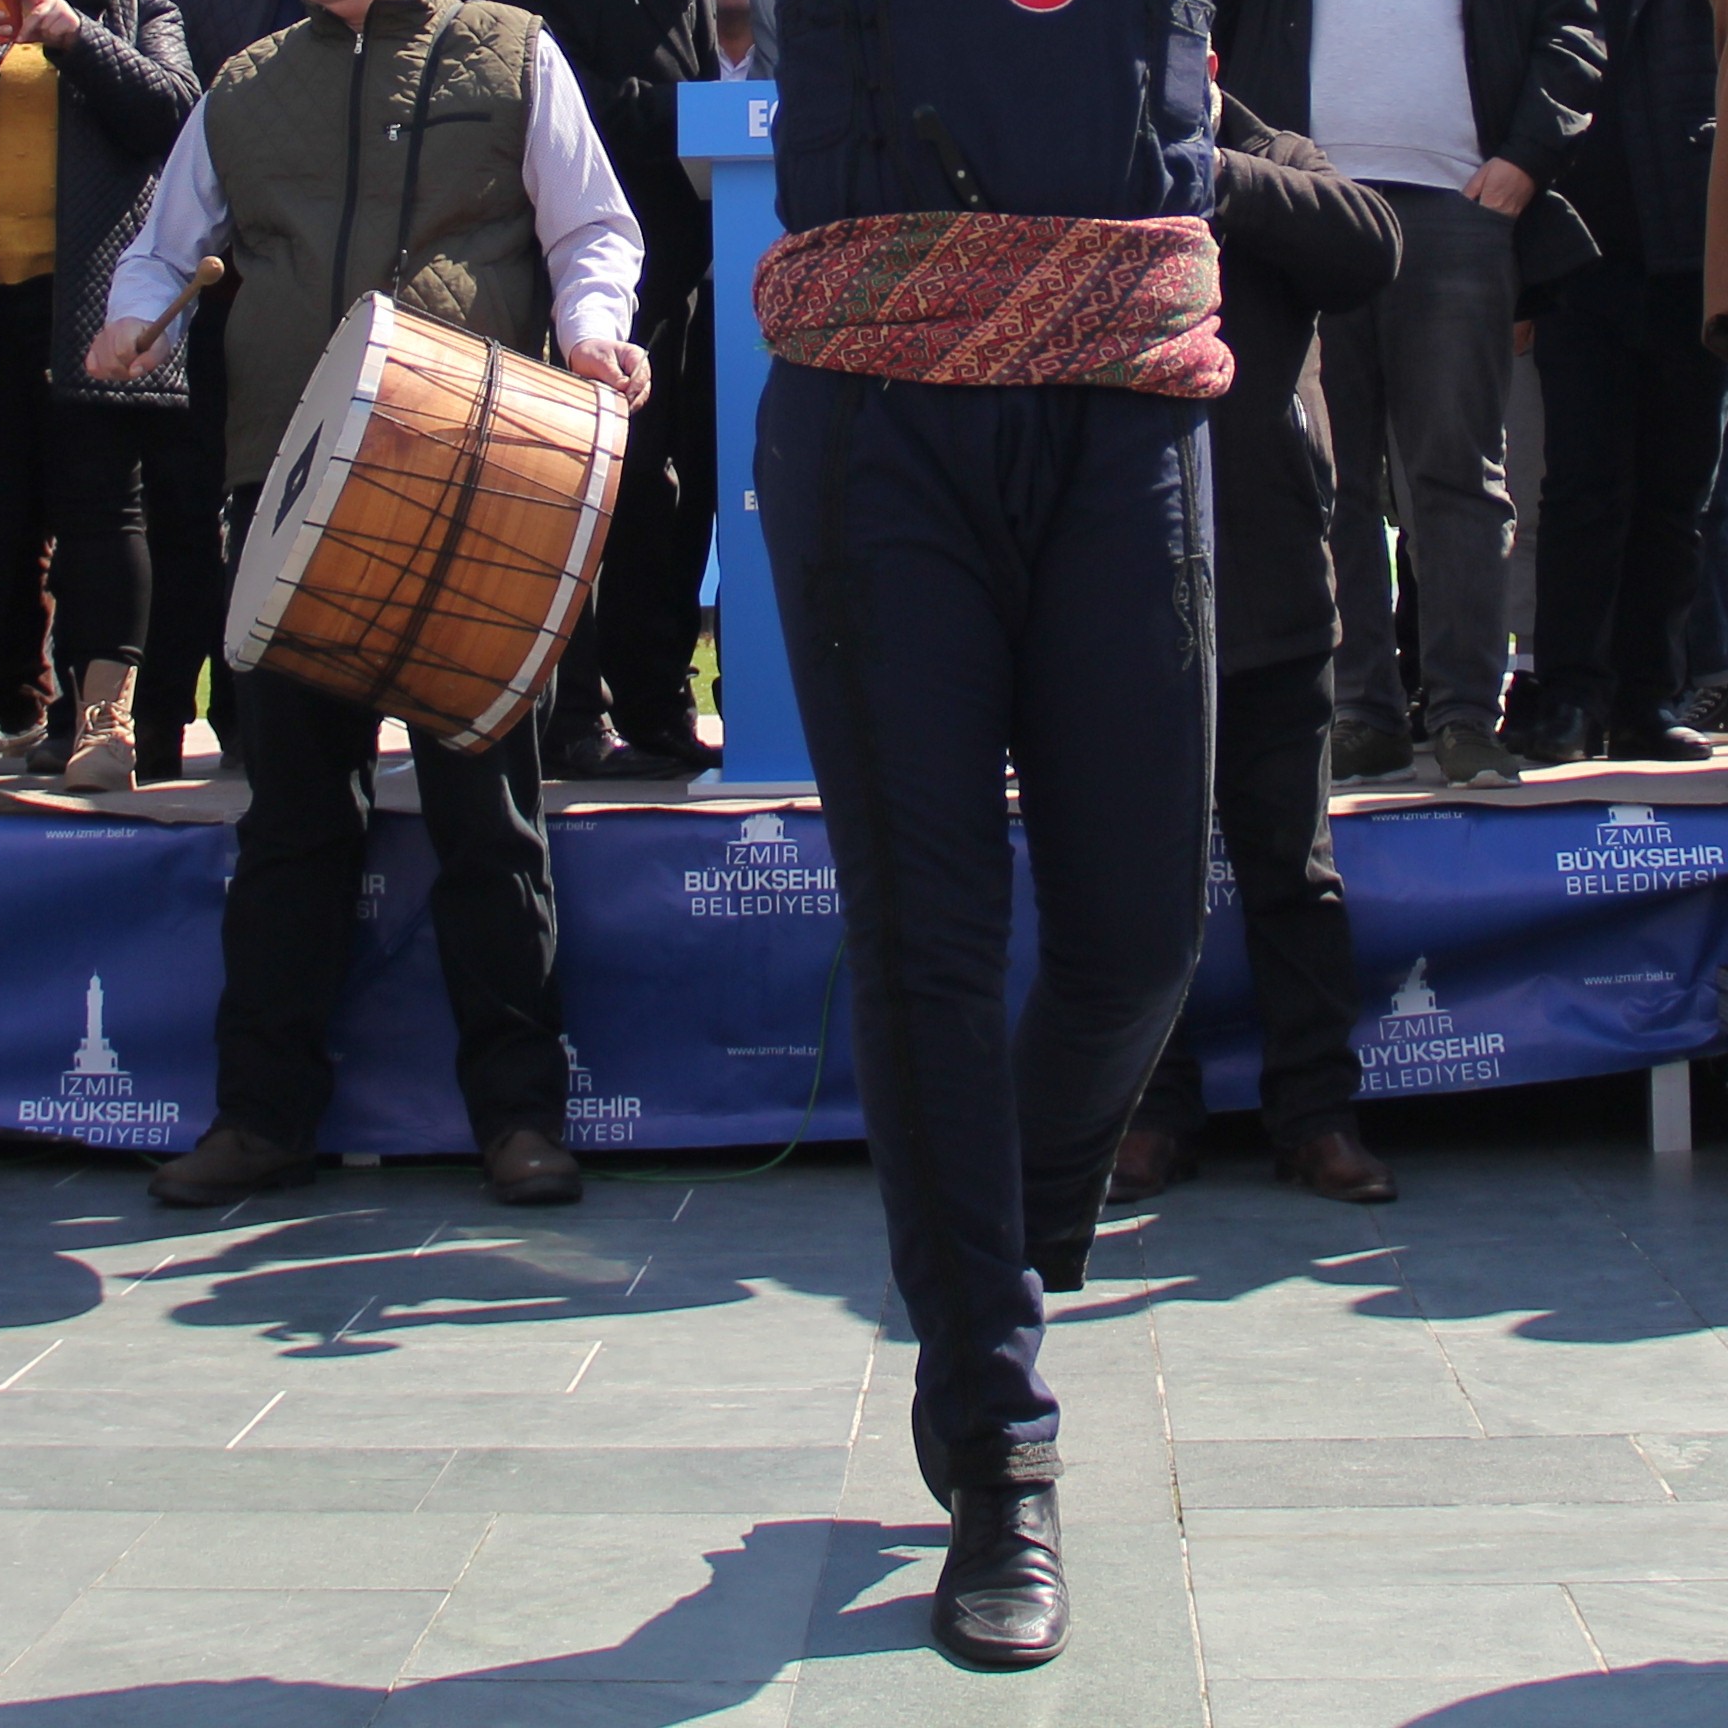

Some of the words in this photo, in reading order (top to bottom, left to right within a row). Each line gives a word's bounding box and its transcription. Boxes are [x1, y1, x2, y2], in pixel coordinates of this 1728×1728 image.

[748, 99, 779, 138] E
[1596, 826, 1673, 846] İZMİR
[725, 844, 799, 865] İZMİR
[1556, 845, 1725, 872] BÜYÜKŞEHİR
[691, 893, 840, 916] BELEDİYESİ
[1379, 1015, 1454, 1040] İZMİR
[60, 1075, 133, 1096] İZMİR
[18, 1097, 180, 1124] BÜYÜKŞEHİR
